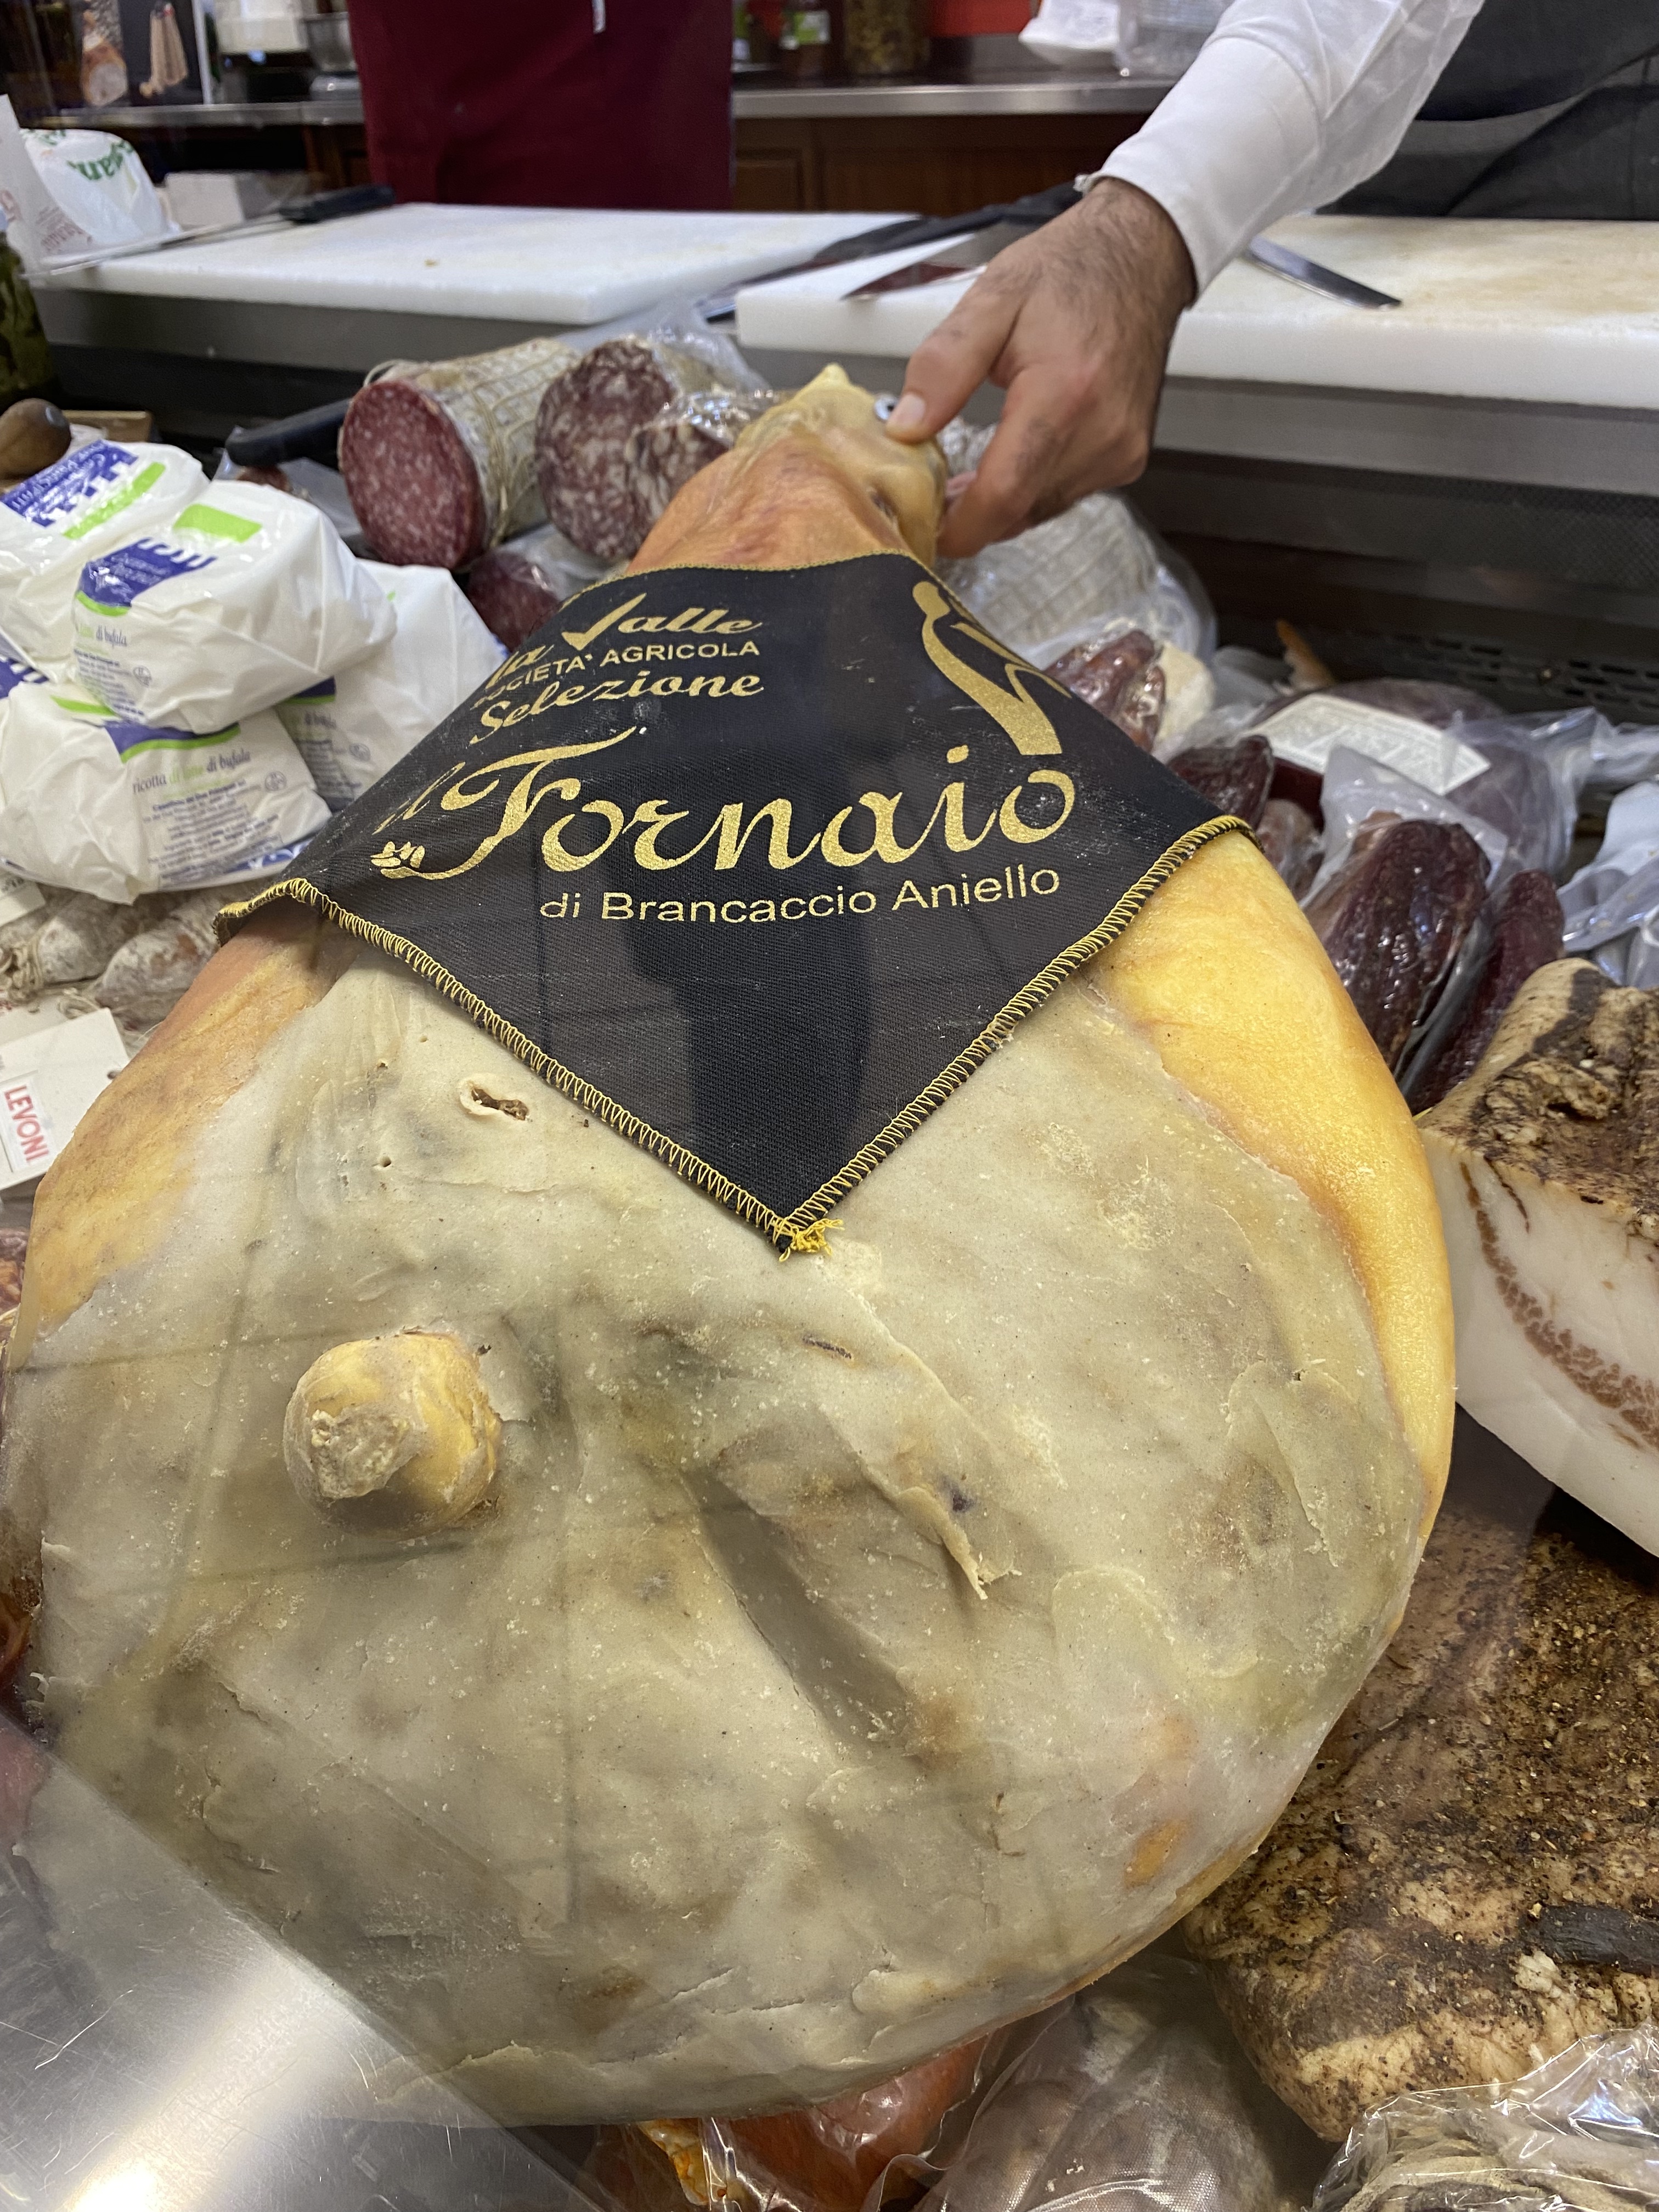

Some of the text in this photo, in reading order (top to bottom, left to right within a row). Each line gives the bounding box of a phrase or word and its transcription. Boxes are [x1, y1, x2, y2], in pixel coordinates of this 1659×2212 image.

[600, 641, 760, 668] AGRICOLA
[469, 670, 764, 745] Selezione
[132, 773, 167, 794] ricotta
[380, 725, 1075, 881] Fornaio
[540, 864, 1060, 923] di Brancaccio Aniello
[4, 1085, 50, 1163] LEVONI
